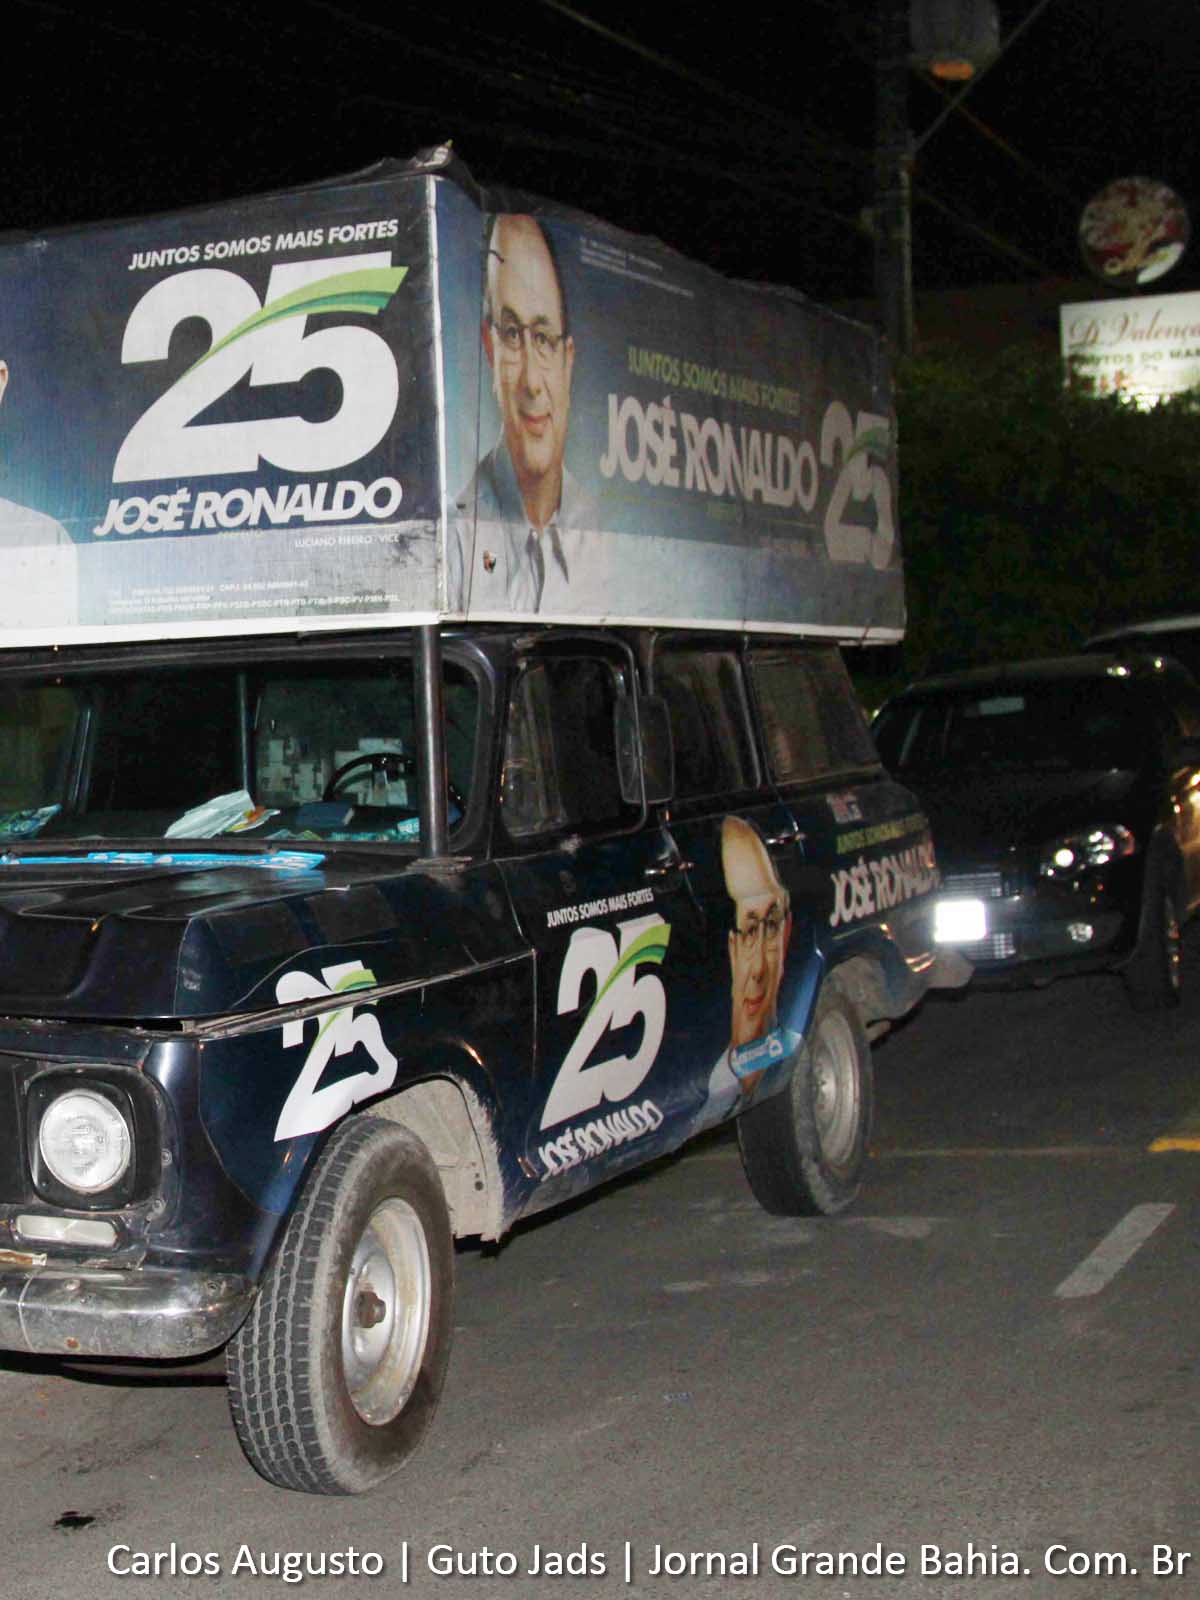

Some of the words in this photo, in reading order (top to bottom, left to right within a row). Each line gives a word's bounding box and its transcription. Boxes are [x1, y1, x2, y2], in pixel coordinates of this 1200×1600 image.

[128, 245, 200, 270] JUNTOS
[204, 236, 271, 260] SOMOS
[275, 228, 323, 251] MAIS
[328, 219, 399, 245] FORTES
[112, 250, 408, 484] 25
[628, 346, 680, 387] JUNTOS
[682, 360, 727, 398] SOMOS
[600, 394, 680, 487] JOSÉ
[680, 412, 818, 514] RONALDO
[820, 400, 896, 570] 25
[94, 485, 193, 536] JOSÉ
[190, 476, 403, 530] RONALDO
[546, 905, 579, 928] JUNTOS
[579, 898, 609, 920] SOMOS
[608, 893, 628, 912] MAIS
[627, 887, 654, 908] FORTES
[829, 855, 876, 928] JOSÉ
[274, 960, 398, 1142] 25
[540, 913, 671, 1131] 25
[539, 1127, 579, 1181] JOSÉ
[575, 1099, 664, 1158] RONALDO
